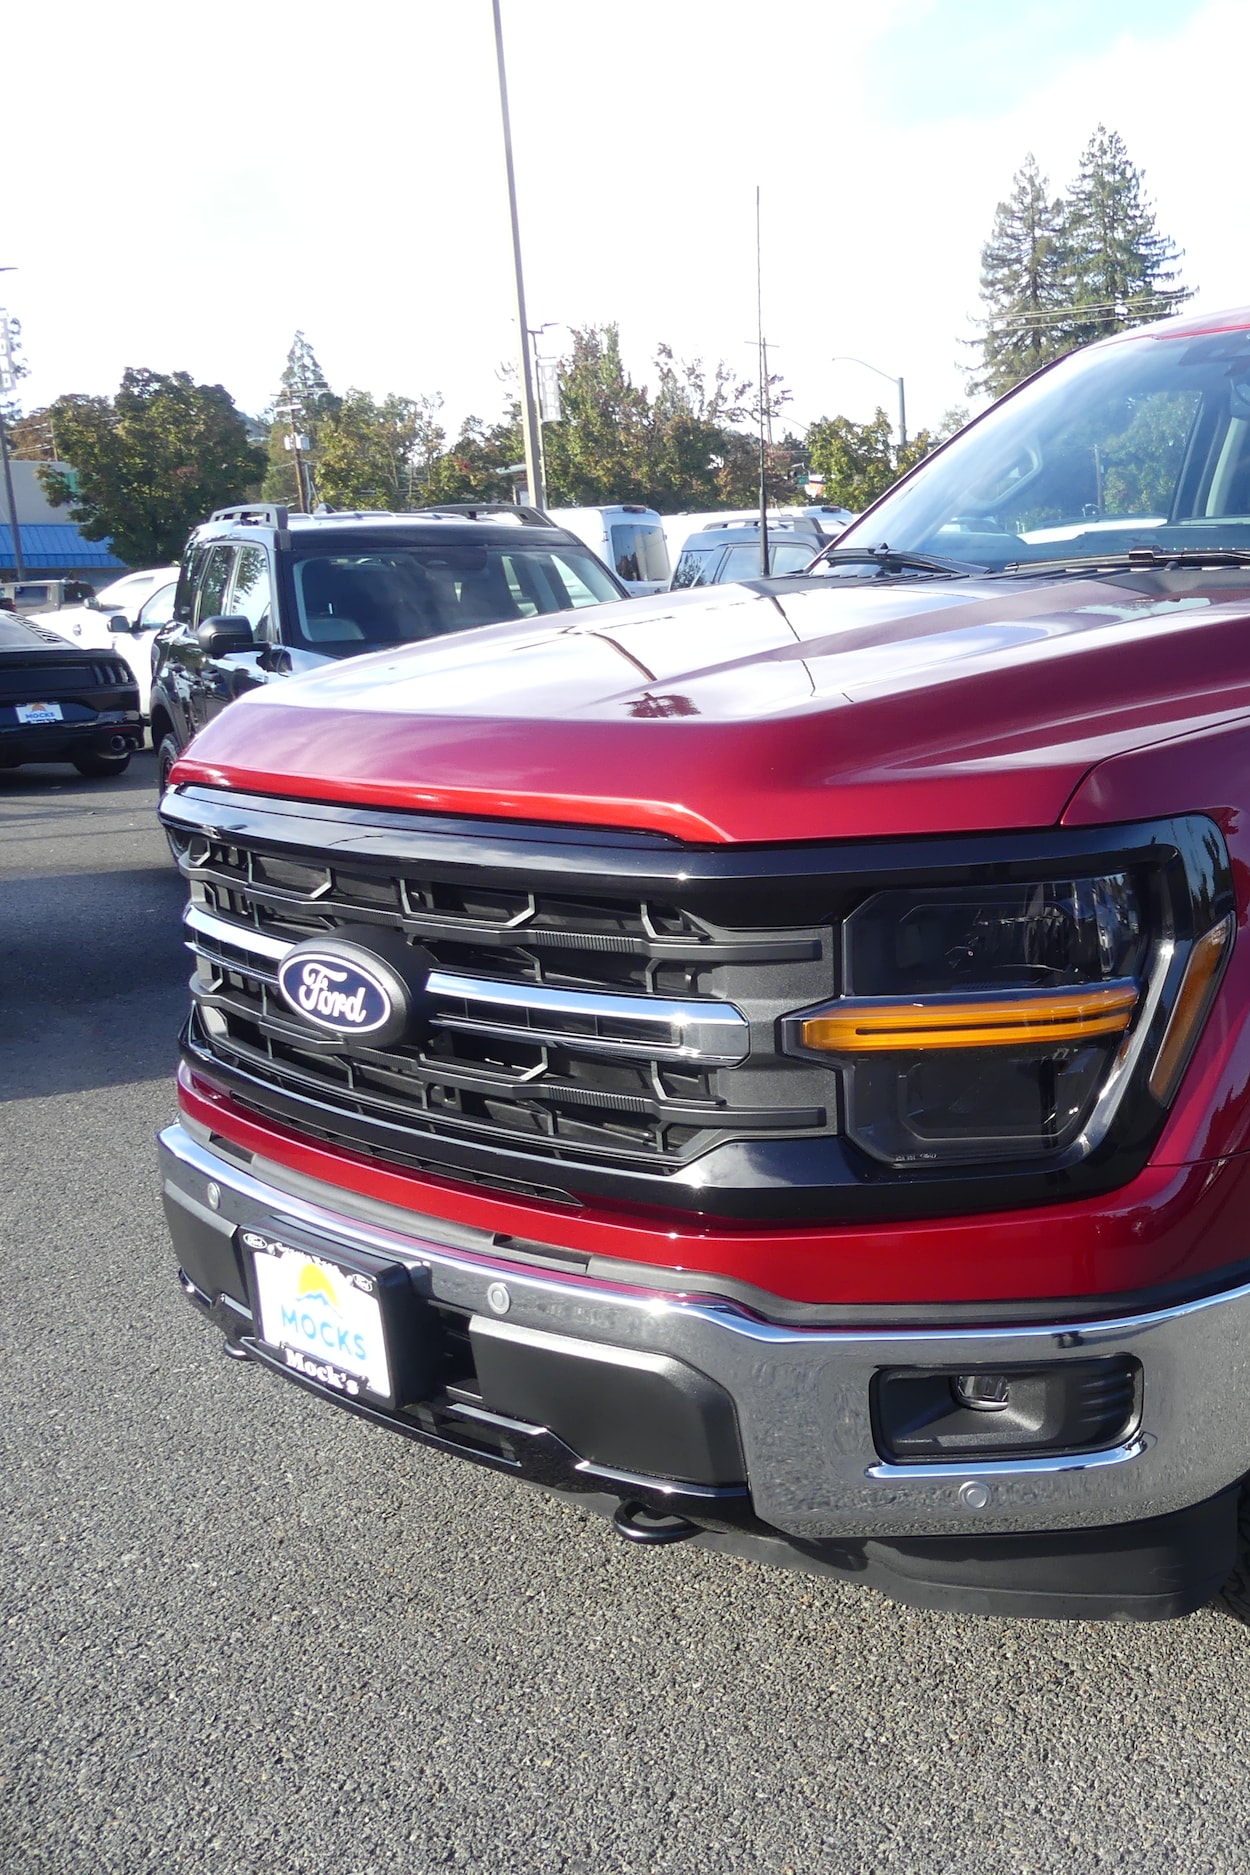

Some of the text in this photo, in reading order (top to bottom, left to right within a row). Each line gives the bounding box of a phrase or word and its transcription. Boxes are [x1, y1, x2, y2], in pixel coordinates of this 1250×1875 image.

[25, 711, 56, 719] MOCKS
[298, 962, 367, 1024] Ford
[280, 1303, 367, 1361] MOCKS
[284, 1347, 360, 1396] Mock's
